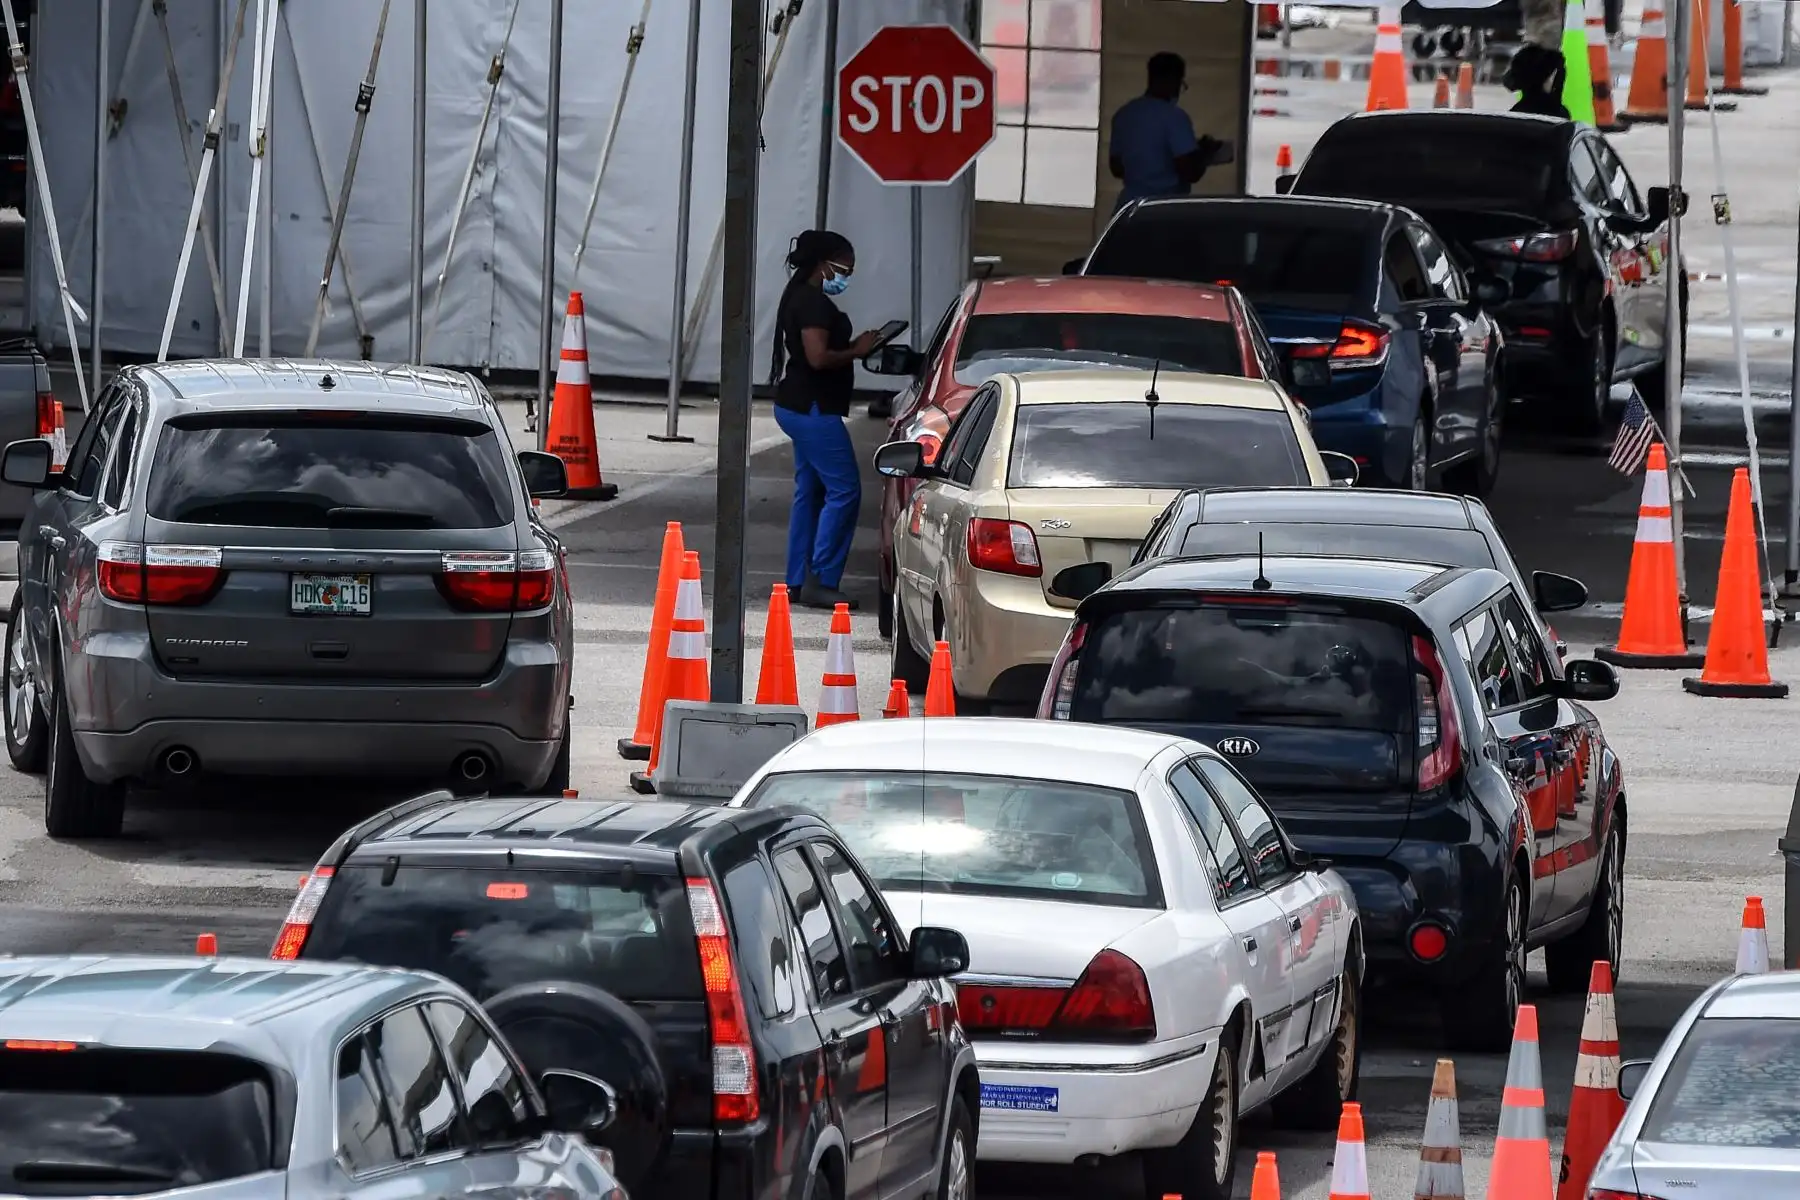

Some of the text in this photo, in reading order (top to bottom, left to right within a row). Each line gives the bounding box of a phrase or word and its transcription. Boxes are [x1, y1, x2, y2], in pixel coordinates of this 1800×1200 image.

[848, 75, 985, 134] STOP
[294, 583, 368, 605] HDK C16
[1224, 740, 1253, 754] KIA
[980, 1099, 1050, 1110] NOR ROLL STUDENT
